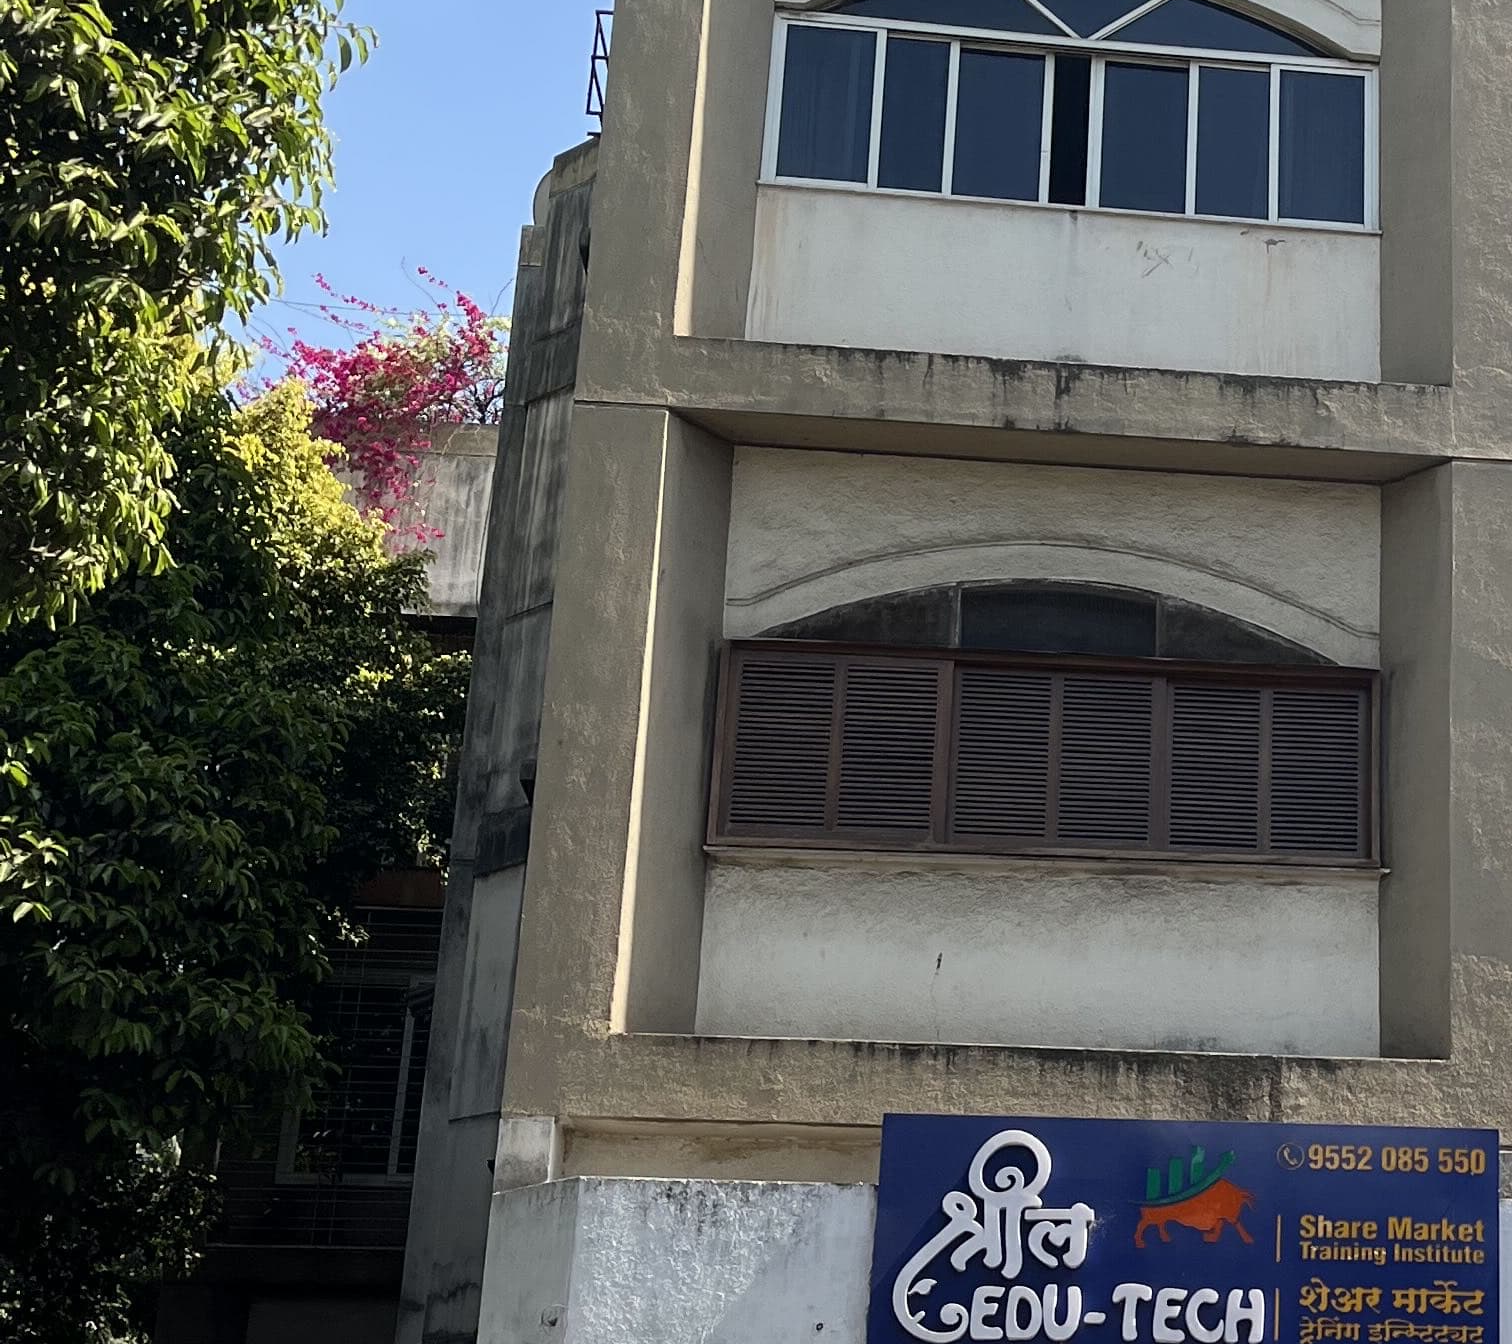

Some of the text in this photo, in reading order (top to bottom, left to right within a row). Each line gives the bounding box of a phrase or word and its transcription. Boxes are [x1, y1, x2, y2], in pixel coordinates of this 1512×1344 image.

[1308, 1144, 1486, 1174] 9552 085 550
[1299, 1214, 1485, 1243] Share Market
[1300, 1242, 1485, 1265] Training Institute
[1299, 1276, 1486, 1315] शेअर मार्केट
[970, 1282, 1266, 1344] EDU-TECH
[1299, 1316, 1361, 1344] ट्रेनिंग
